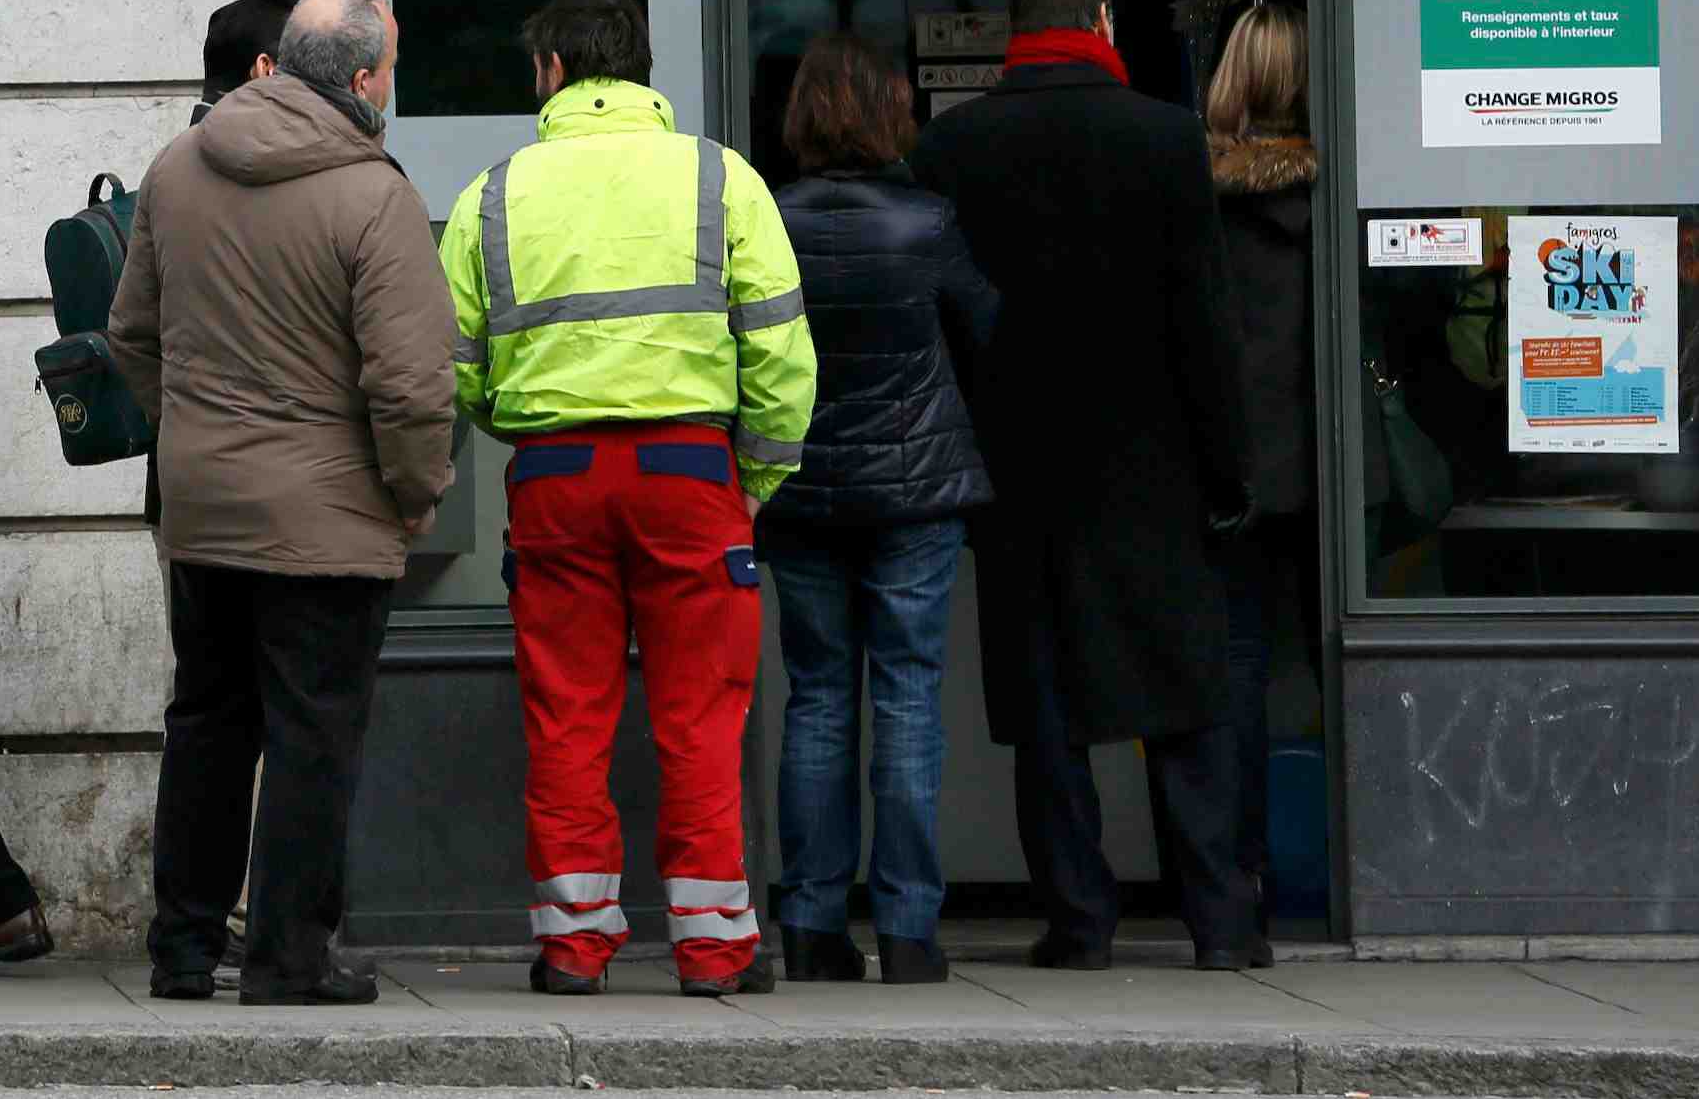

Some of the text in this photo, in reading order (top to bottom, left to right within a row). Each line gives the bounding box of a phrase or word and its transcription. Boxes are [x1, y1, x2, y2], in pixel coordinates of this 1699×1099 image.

[1462, 11, 1618, 24] Renseignements et taux
[1471, 27, 1537, 40] disponible
[1541, 27, 1549, 37] à
[1465, 92, 1618, 106] CHANGE MIGROS
[1566, 222, 1618, 245] famigros
[1546, 242, 1636, 285] SKI
